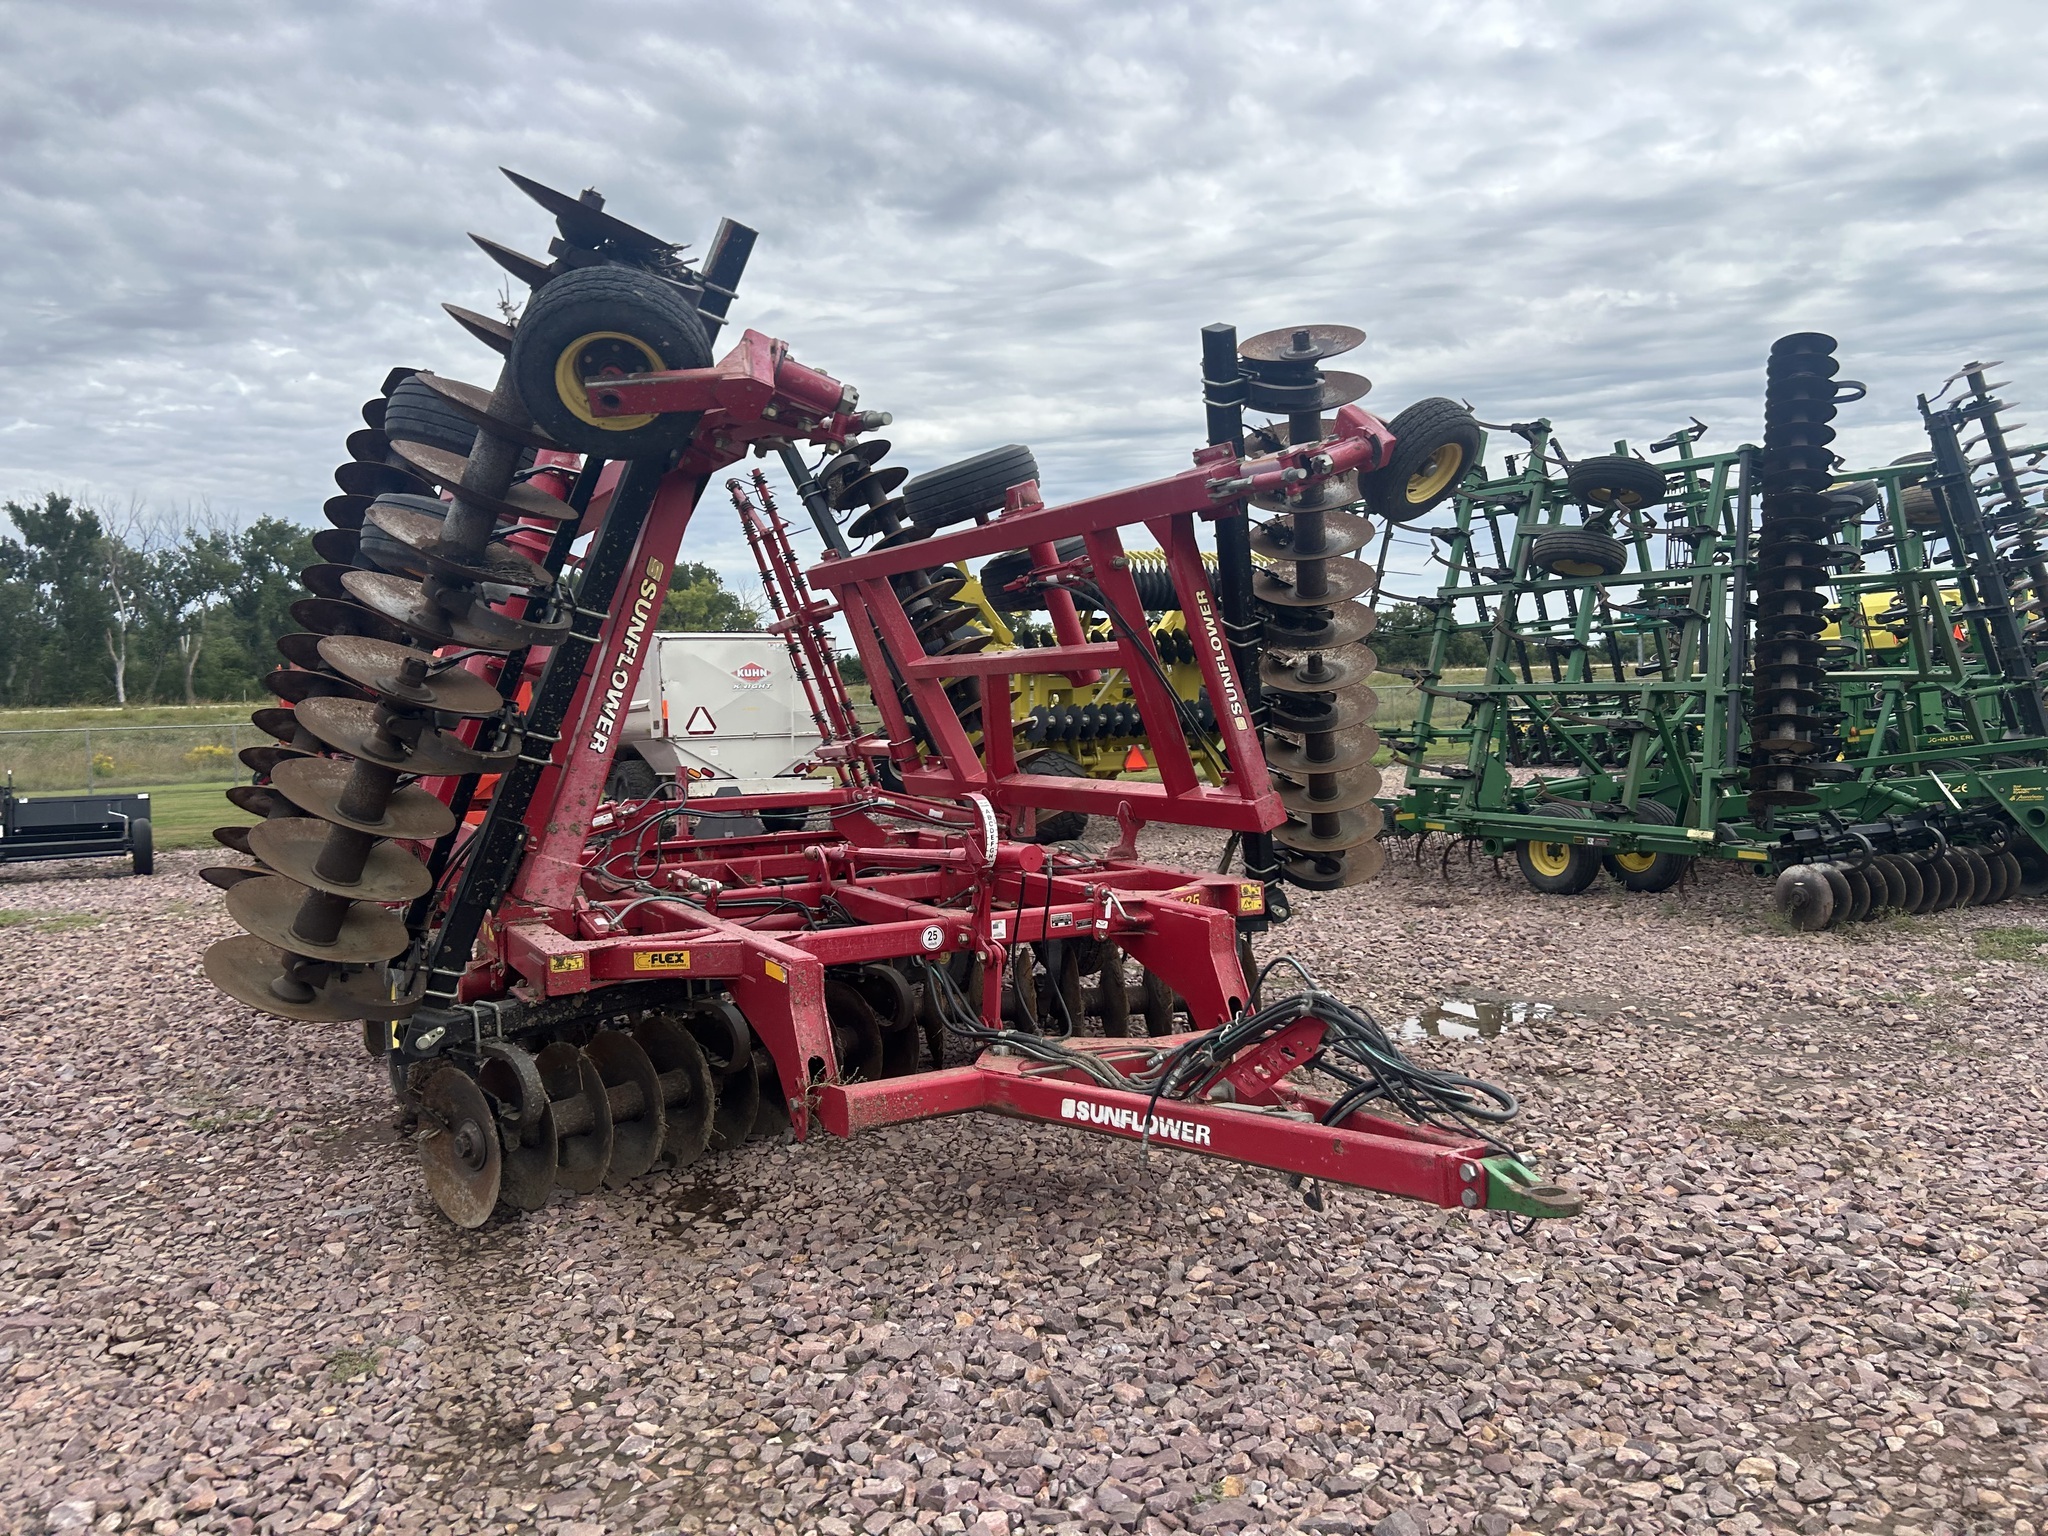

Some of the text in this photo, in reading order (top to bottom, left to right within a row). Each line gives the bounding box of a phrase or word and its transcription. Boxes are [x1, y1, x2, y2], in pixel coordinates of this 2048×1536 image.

[589, 578, 658, 754] SUNFLOWER
[737, 668, 768, 678] KUHN
[1195, 590, 1243, 716] SUNFLOWER
[927, 930, 938, 941] 25
[1076, 1101, 1211, 1146] SUNFLOWER
